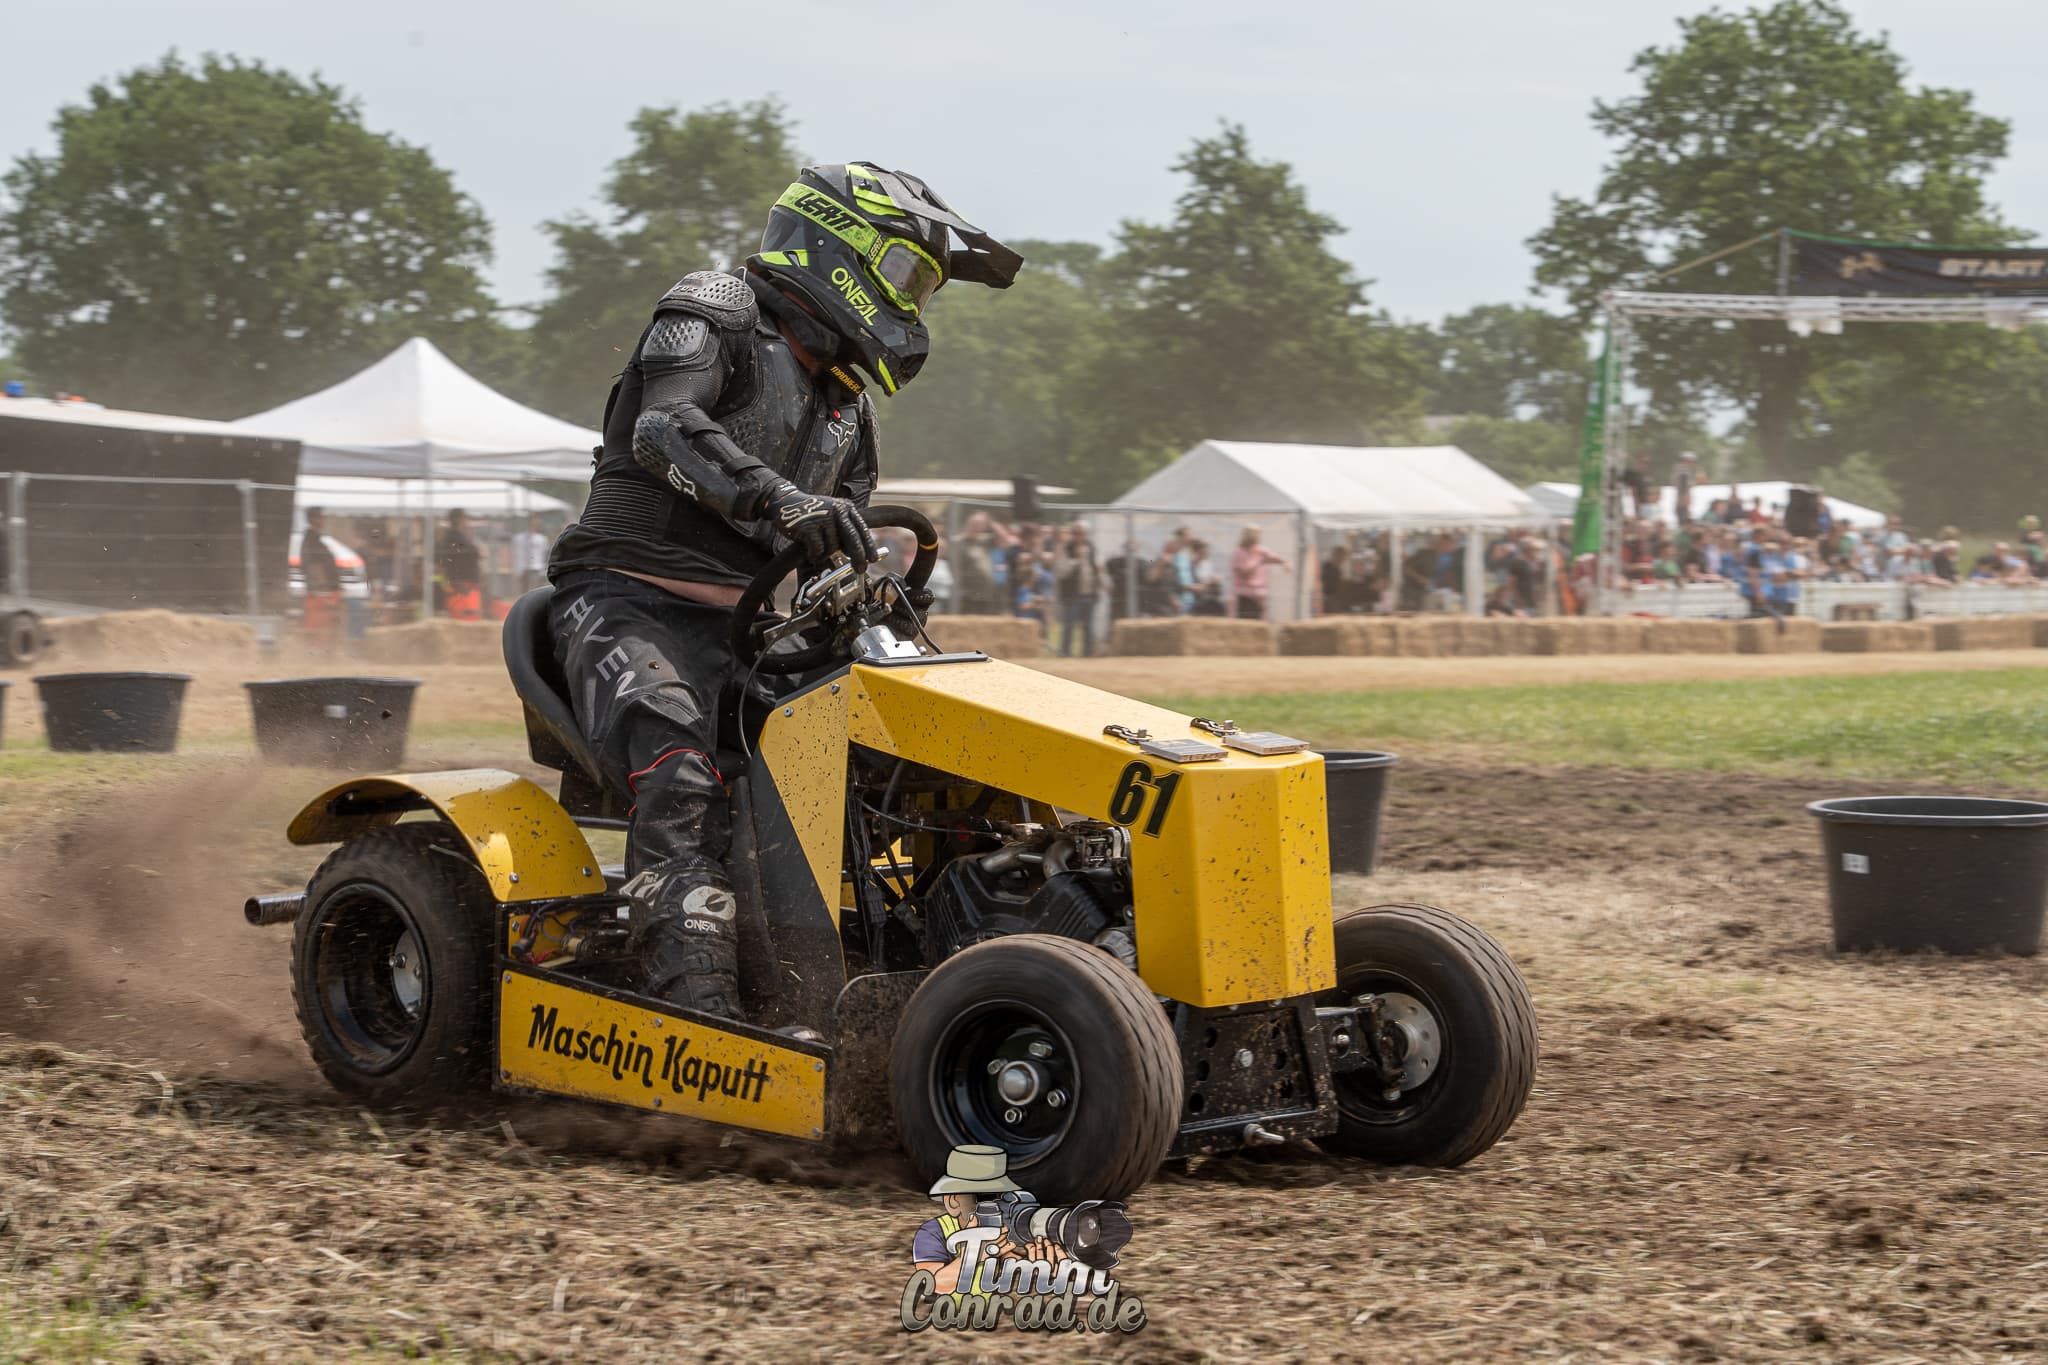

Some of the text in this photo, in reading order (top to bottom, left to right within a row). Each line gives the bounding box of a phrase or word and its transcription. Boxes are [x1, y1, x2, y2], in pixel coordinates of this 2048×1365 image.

[794, 191, 868, 233] LEATT
[1108, 759, 1184, 839] 61
[528, 1003, 771, 1104] Maschin Kaputt
